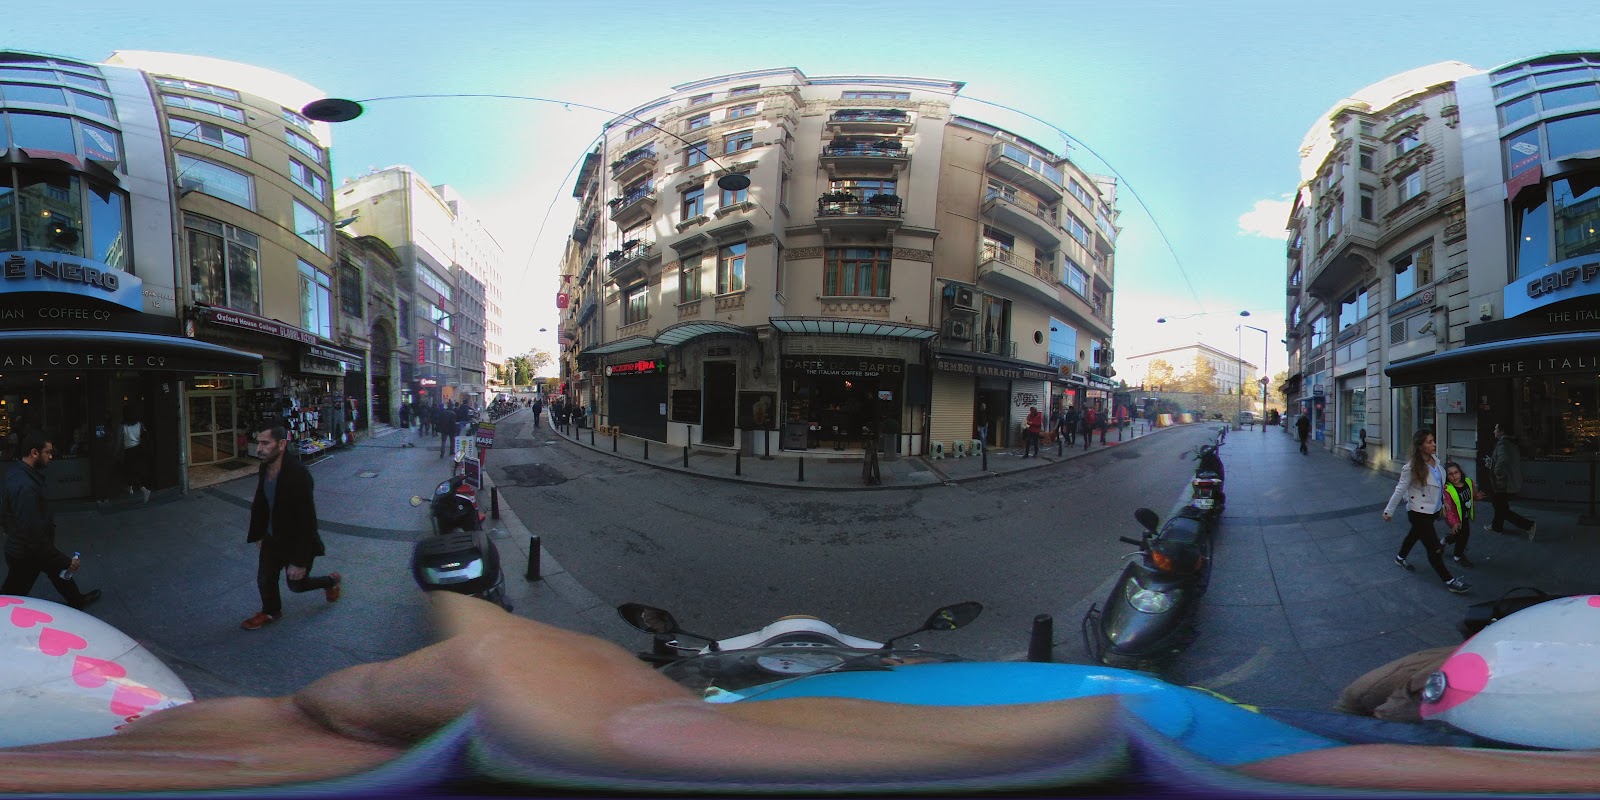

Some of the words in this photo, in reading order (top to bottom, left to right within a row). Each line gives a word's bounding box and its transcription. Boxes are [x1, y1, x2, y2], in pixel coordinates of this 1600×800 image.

[34, 259, 119, 292] NERO
[152, 300, 161, 309] 12
[38, 308, 89, 320] COFFEE
[216, 313, 238, 323] Oxford
[239, 318, 257, 327] House
[1547, 311, 1571, 322] THE
[48, 354, 135, 366] COFFEE
[635, 360, 656, 372] PERA
[860, 361, 900, 374] SARTO
[937, 361, 975, 374] SEMBOL
[1490, 362, 1524, 373] THE
[476, 437, 494, 445] KAŞE
